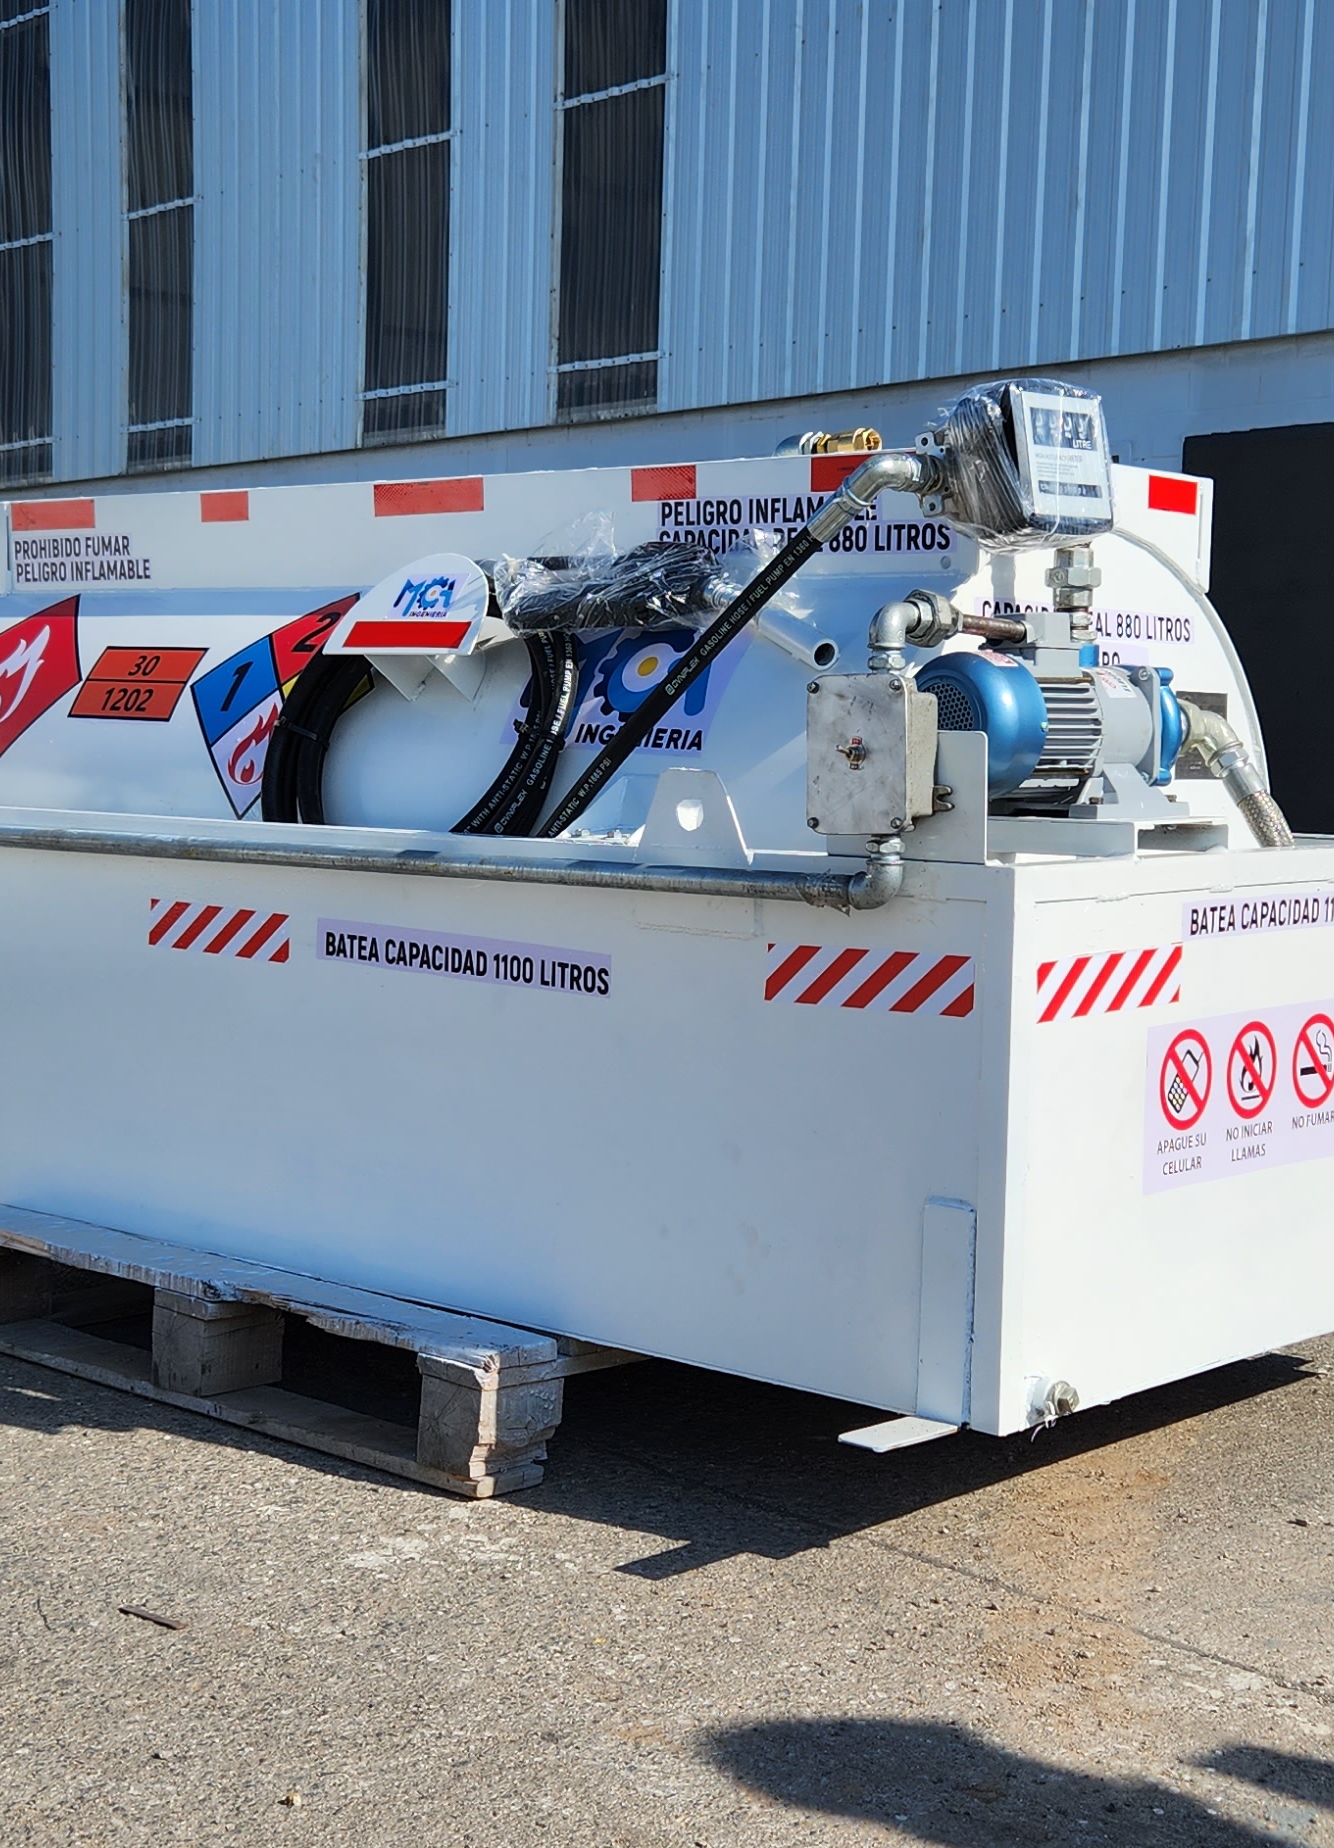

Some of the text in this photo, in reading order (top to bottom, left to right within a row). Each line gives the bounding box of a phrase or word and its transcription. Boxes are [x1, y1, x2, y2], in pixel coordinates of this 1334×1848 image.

[1072, 439, 1092, 449] LITRE
[661, 495, 878, 527] PELIGRO INFLAME
[14, 535, 130, 560] PROHIBIDO FUMAR
[659, 527, 762, 555] CAPACID
[829, 525, 867, 553] 880
[874, 523, 952, 552] LITROS
[17, 559, 151, 583] PELIGRO INFLAMABLE
[699, 623, 732, 656] GASOLINE
[729, 603, 748, 629] HOSE
[750, 582, 768, 604] FUEL
[766, 564, 785, 586] PUMP
[783, 554, 795, 567] EN
[793, 539, 809, 557] 1360
[291, 612, 342, 653] 2
[1117, 612, 1142, 639] 880
[1146, 615, 1191, 642] LITROS
[128, 655, 161, 677] 30
[101, 688, 154, 712] 1202
[220, 661, 255, 712] 1
[527, 744, 553, 786] GASOLINE
[563, 671, 573, 693] PUMP
[574, 723, 703, 751] INGIERIA
[472, 807, 490, 828] WITH
[488, 762, 523, 810] ANTI-STATIC
[547, 797, 580, 838] ANTI-STATIC
[601, 757, 612, 772] PSI
[1190, 904, 1236, 936] BATEA
[1241, 897, 1320, 930] CAPACIDAD
[325, 931, 610, 996] BATEA CAPACIDAD 1100 LITROS
[1226, 1121, 1273, 1142] NO INICIAR
[1292, 1116, 1305, 1130] NO
[1157, 1132, 1207, 1155] APAGUE SU
[1231, 1143, 1266, 1162] LLAMAS
[1162, 1156, 1202, 1176] CELULAR
